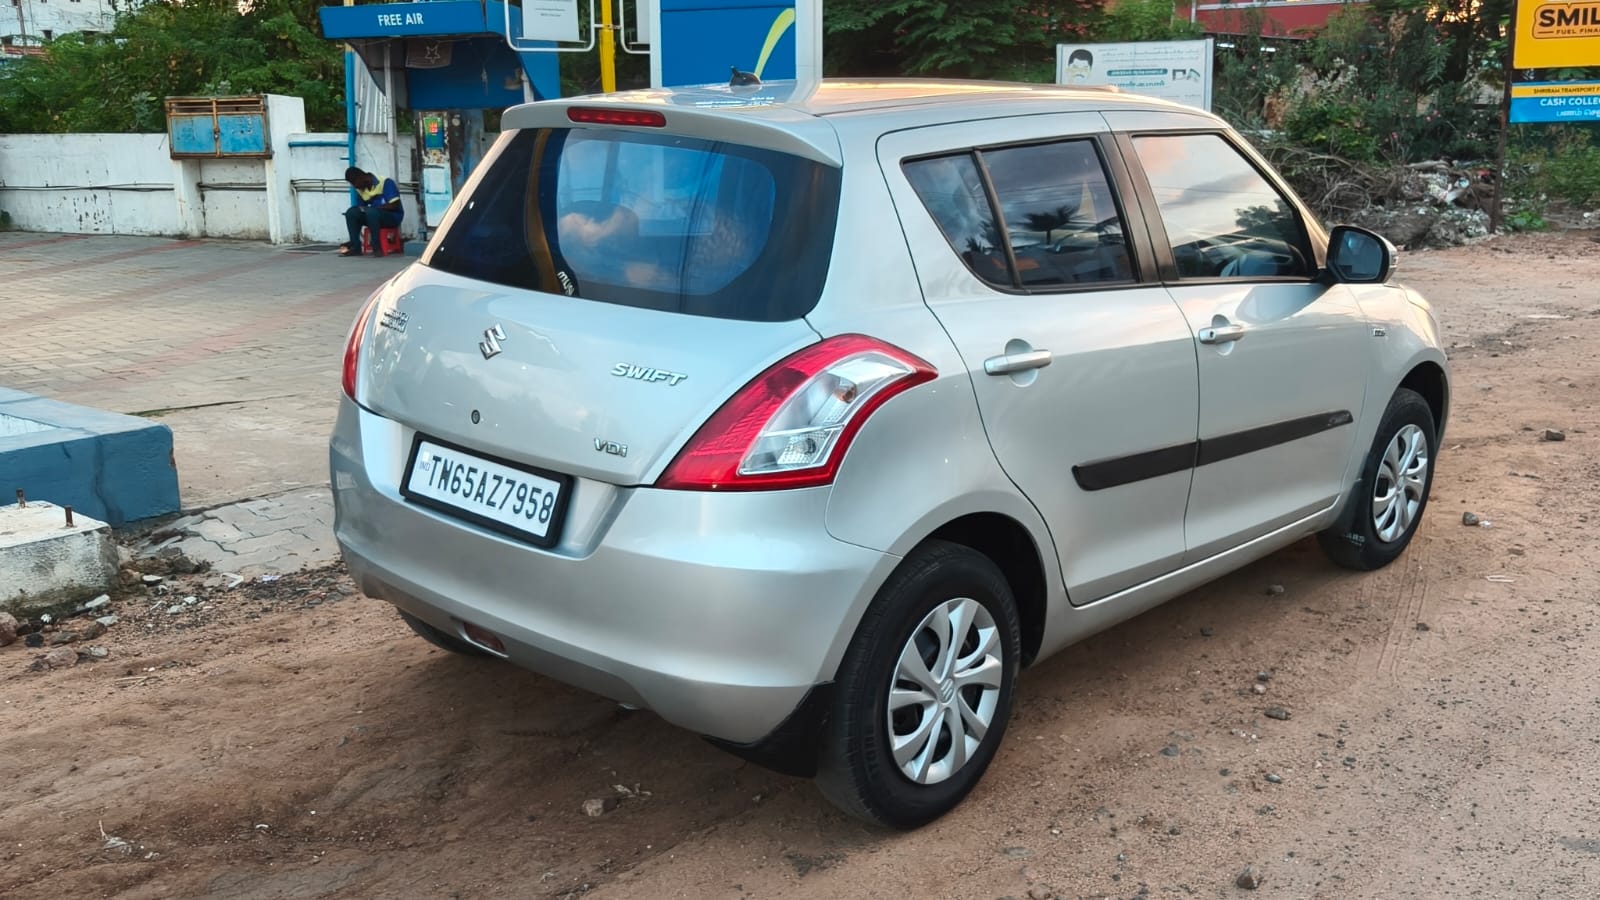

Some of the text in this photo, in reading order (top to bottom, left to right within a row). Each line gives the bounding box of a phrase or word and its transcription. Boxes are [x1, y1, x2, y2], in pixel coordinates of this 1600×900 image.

[377, 13, 424, 27] FREE AIR
[1540, 98, 1566, 106] CASH
[611, 362, 688, 387] SWIFT
[428, 455, 555, 524] TN65AZ7958
